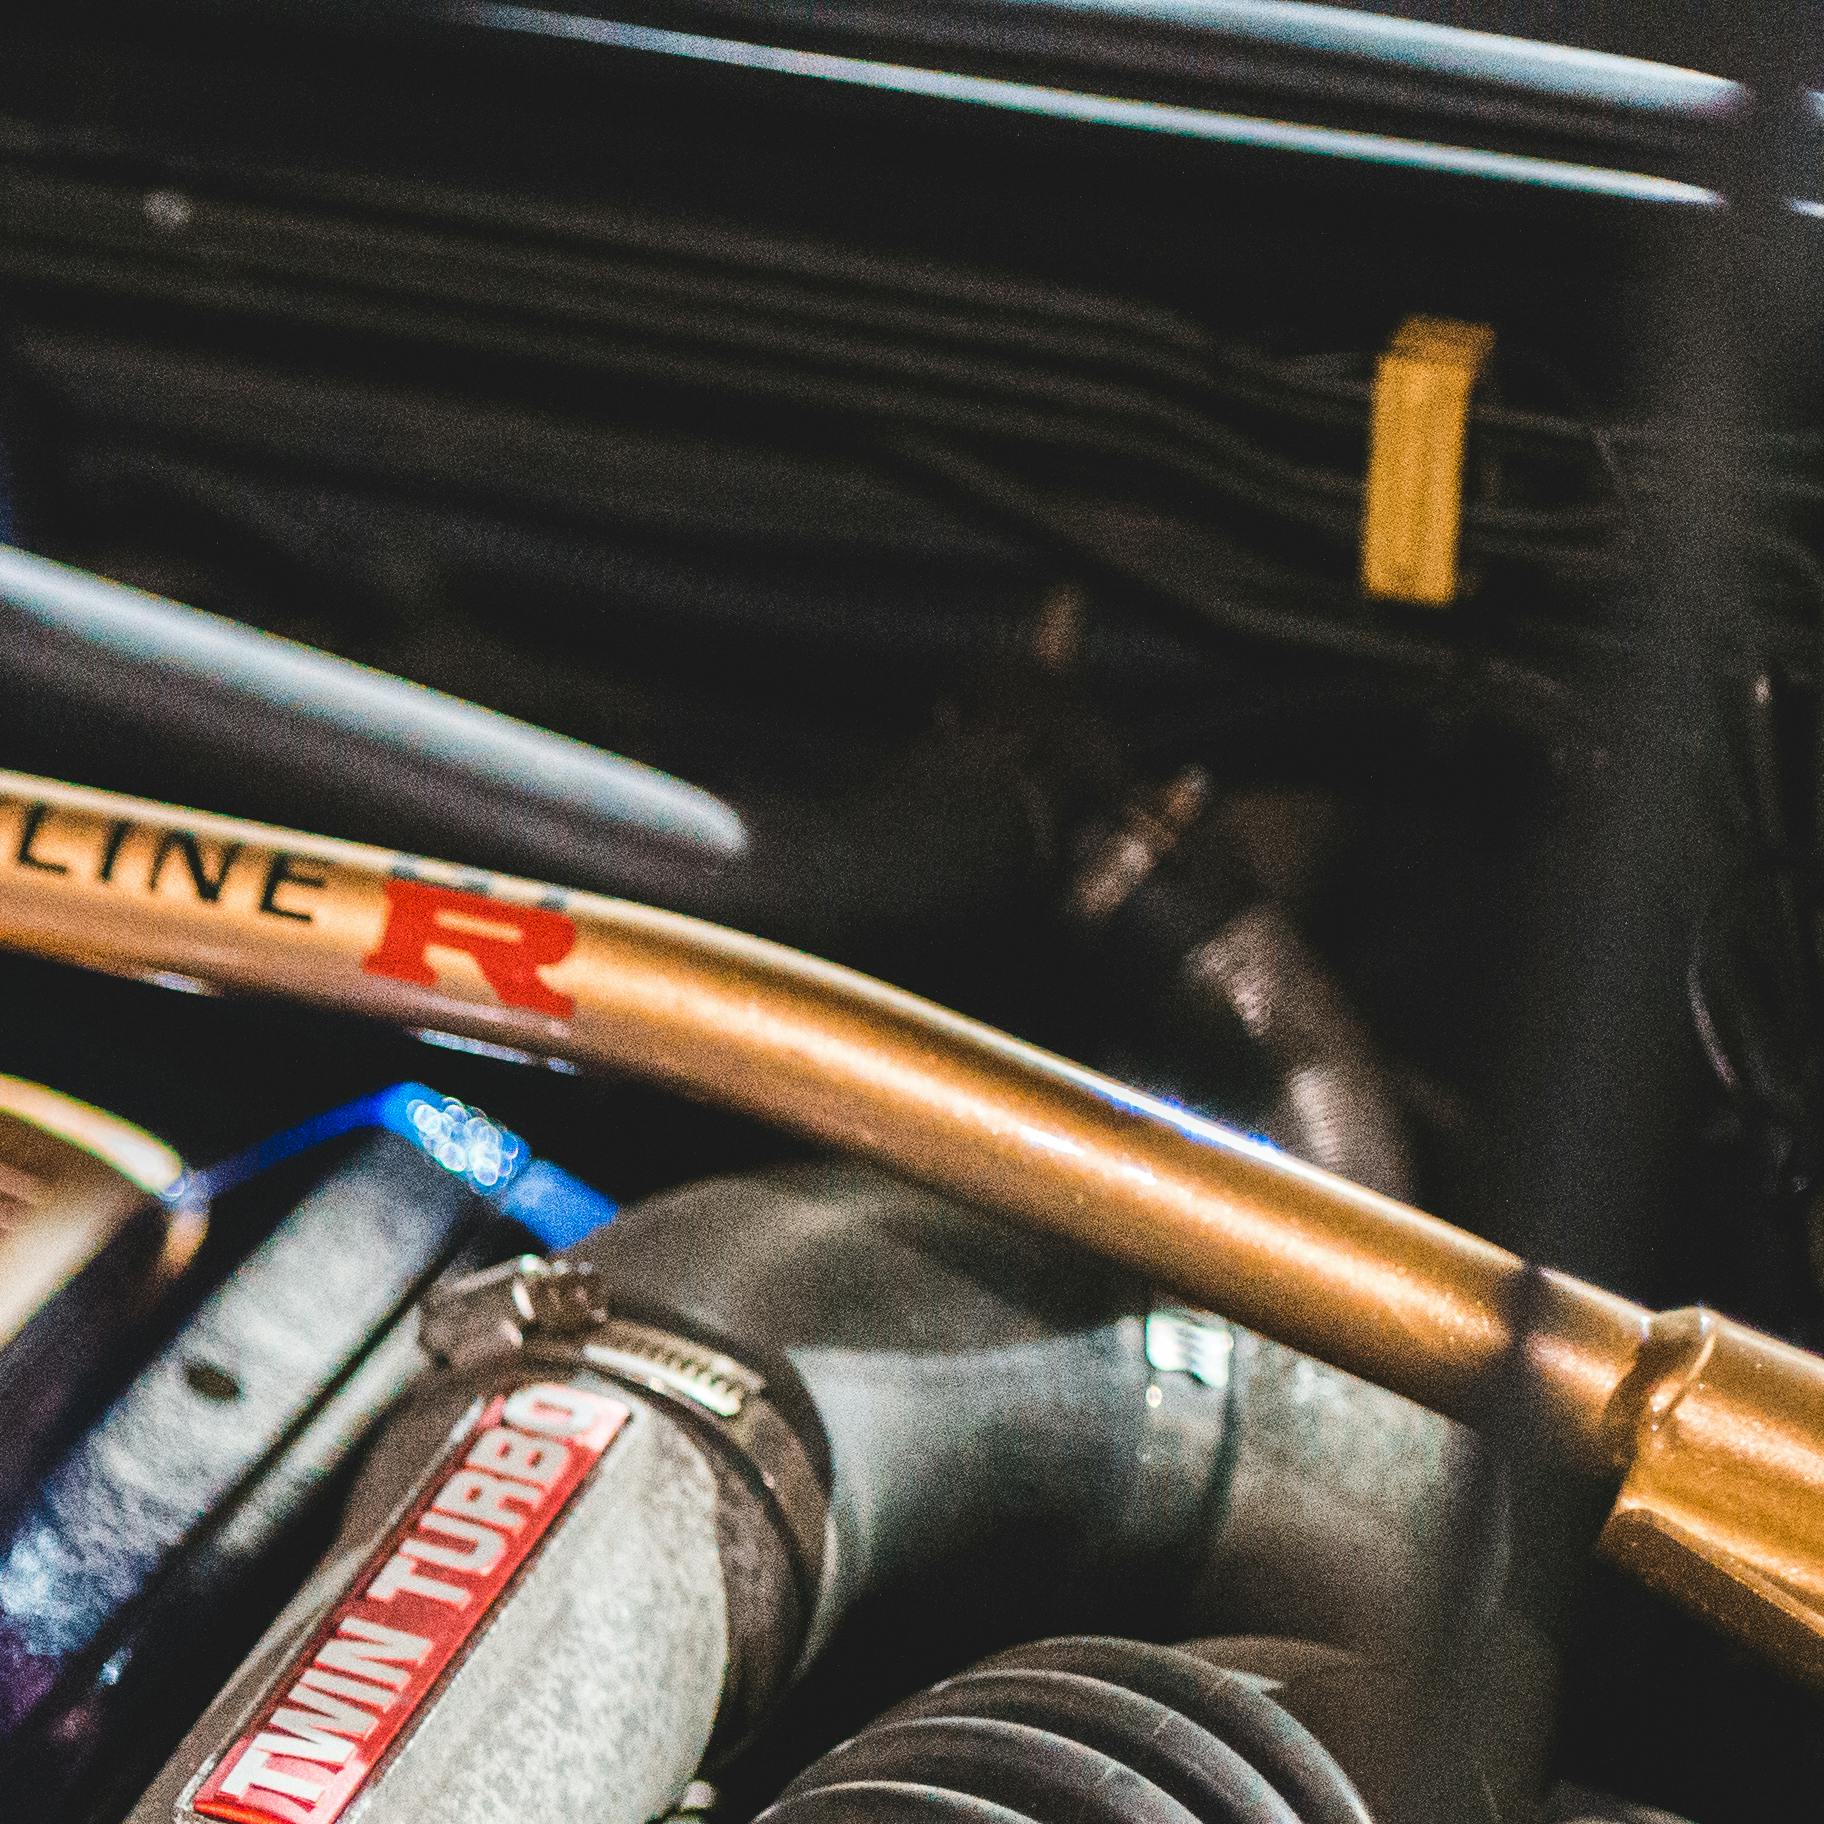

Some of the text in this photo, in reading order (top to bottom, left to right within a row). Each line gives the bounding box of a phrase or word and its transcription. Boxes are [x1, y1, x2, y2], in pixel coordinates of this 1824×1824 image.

[362, 878, 577, 1018] R
[210, 1384, 602, 1810] TWIN TURBO
